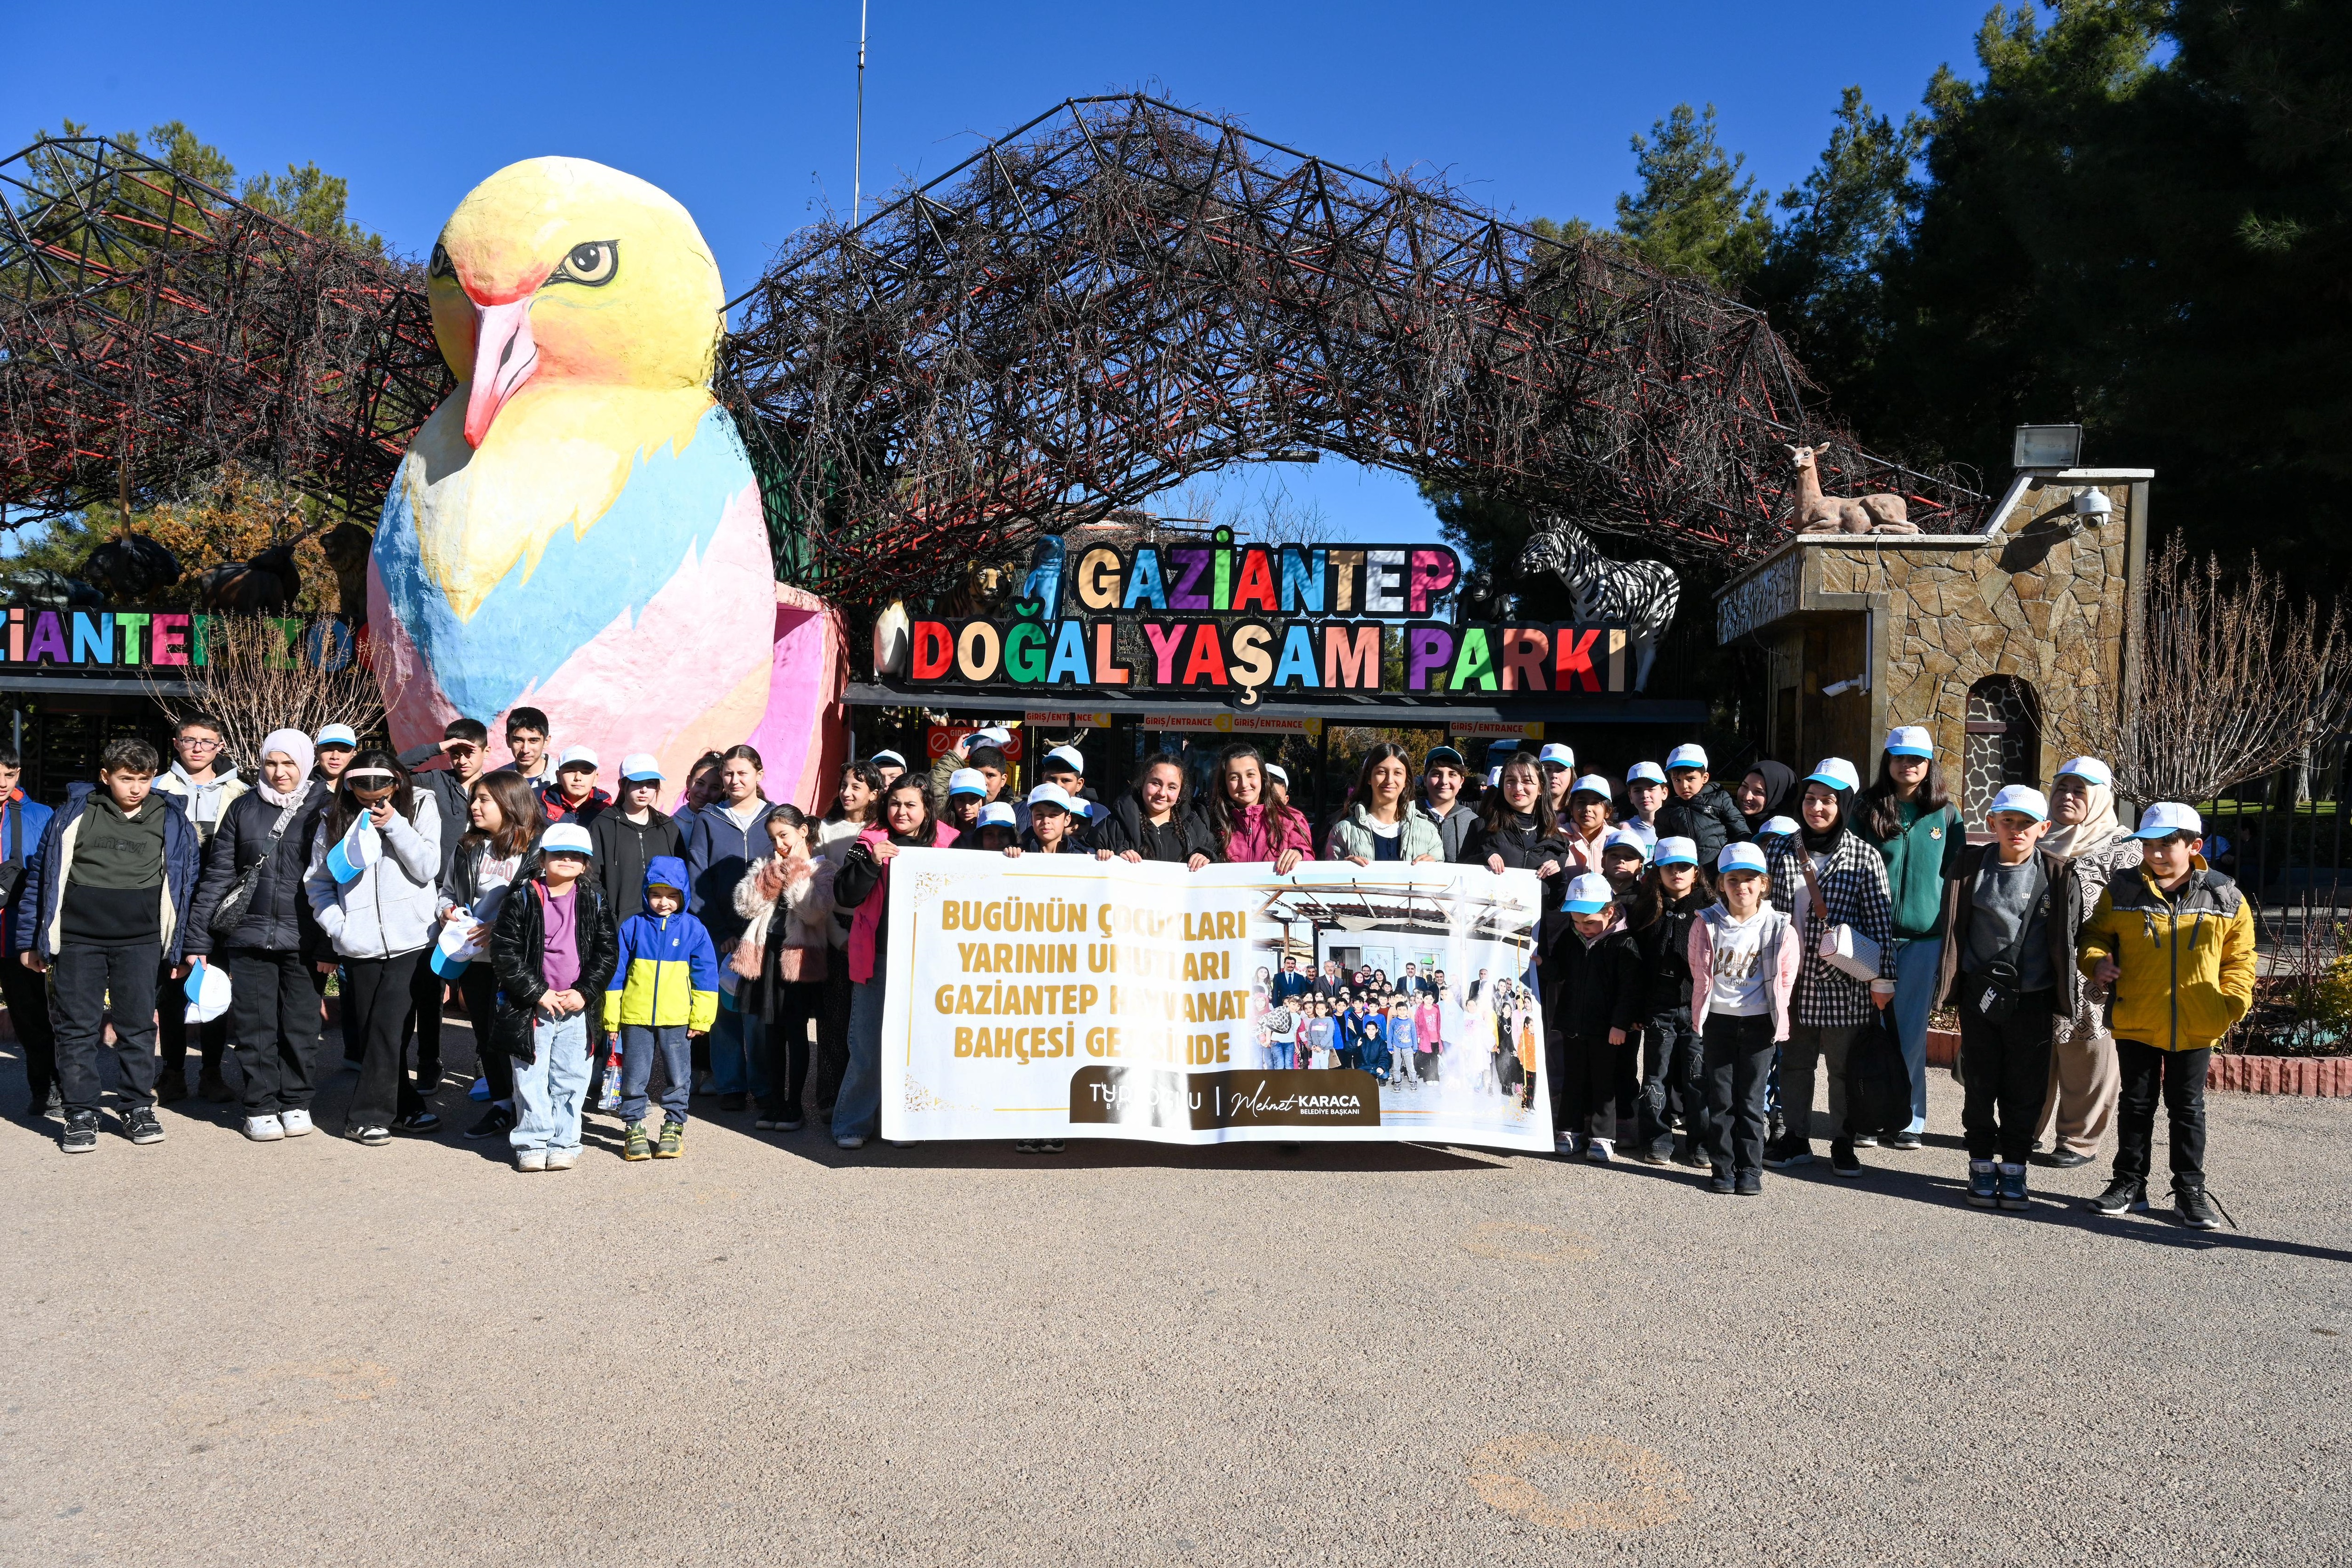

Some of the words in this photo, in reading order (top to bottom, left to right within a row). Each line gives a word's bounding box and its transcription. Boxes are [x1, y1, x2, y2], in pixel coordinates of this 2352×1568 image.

[1078, 529, 1454, 612] GAZİANTEP
[0, 608, 229, 666] İANTEP
[912, 602, 1129, 685] DOĞAL
[1143, 623, 1380, 705] YAŞAM
[1409, 628, 1625, 692] PARKI
[1221, 714, 1229, 729] 3
[1311, 721, 1319, 733] 2
[94, 836, 147, 854] mavi
[942, 896, 1087, 933] BUGÜNÜN
[1097, 903, 1246, 941] ÇOCUKLARI
[957, 942, 1077, 973] YARININ
[935, 979, 1098, 1015] GAZİANTEP
[1979, 986, 1997, 1014] NIKE
[954, 1020, 1074, 1065] BAHÇESİ
[1231, 1080, 1298, 1118] Mehmet
[1298, 1095, 1361, 1107] KARACA
[1330, 1108, 1359, 1116] BAŞKANI
